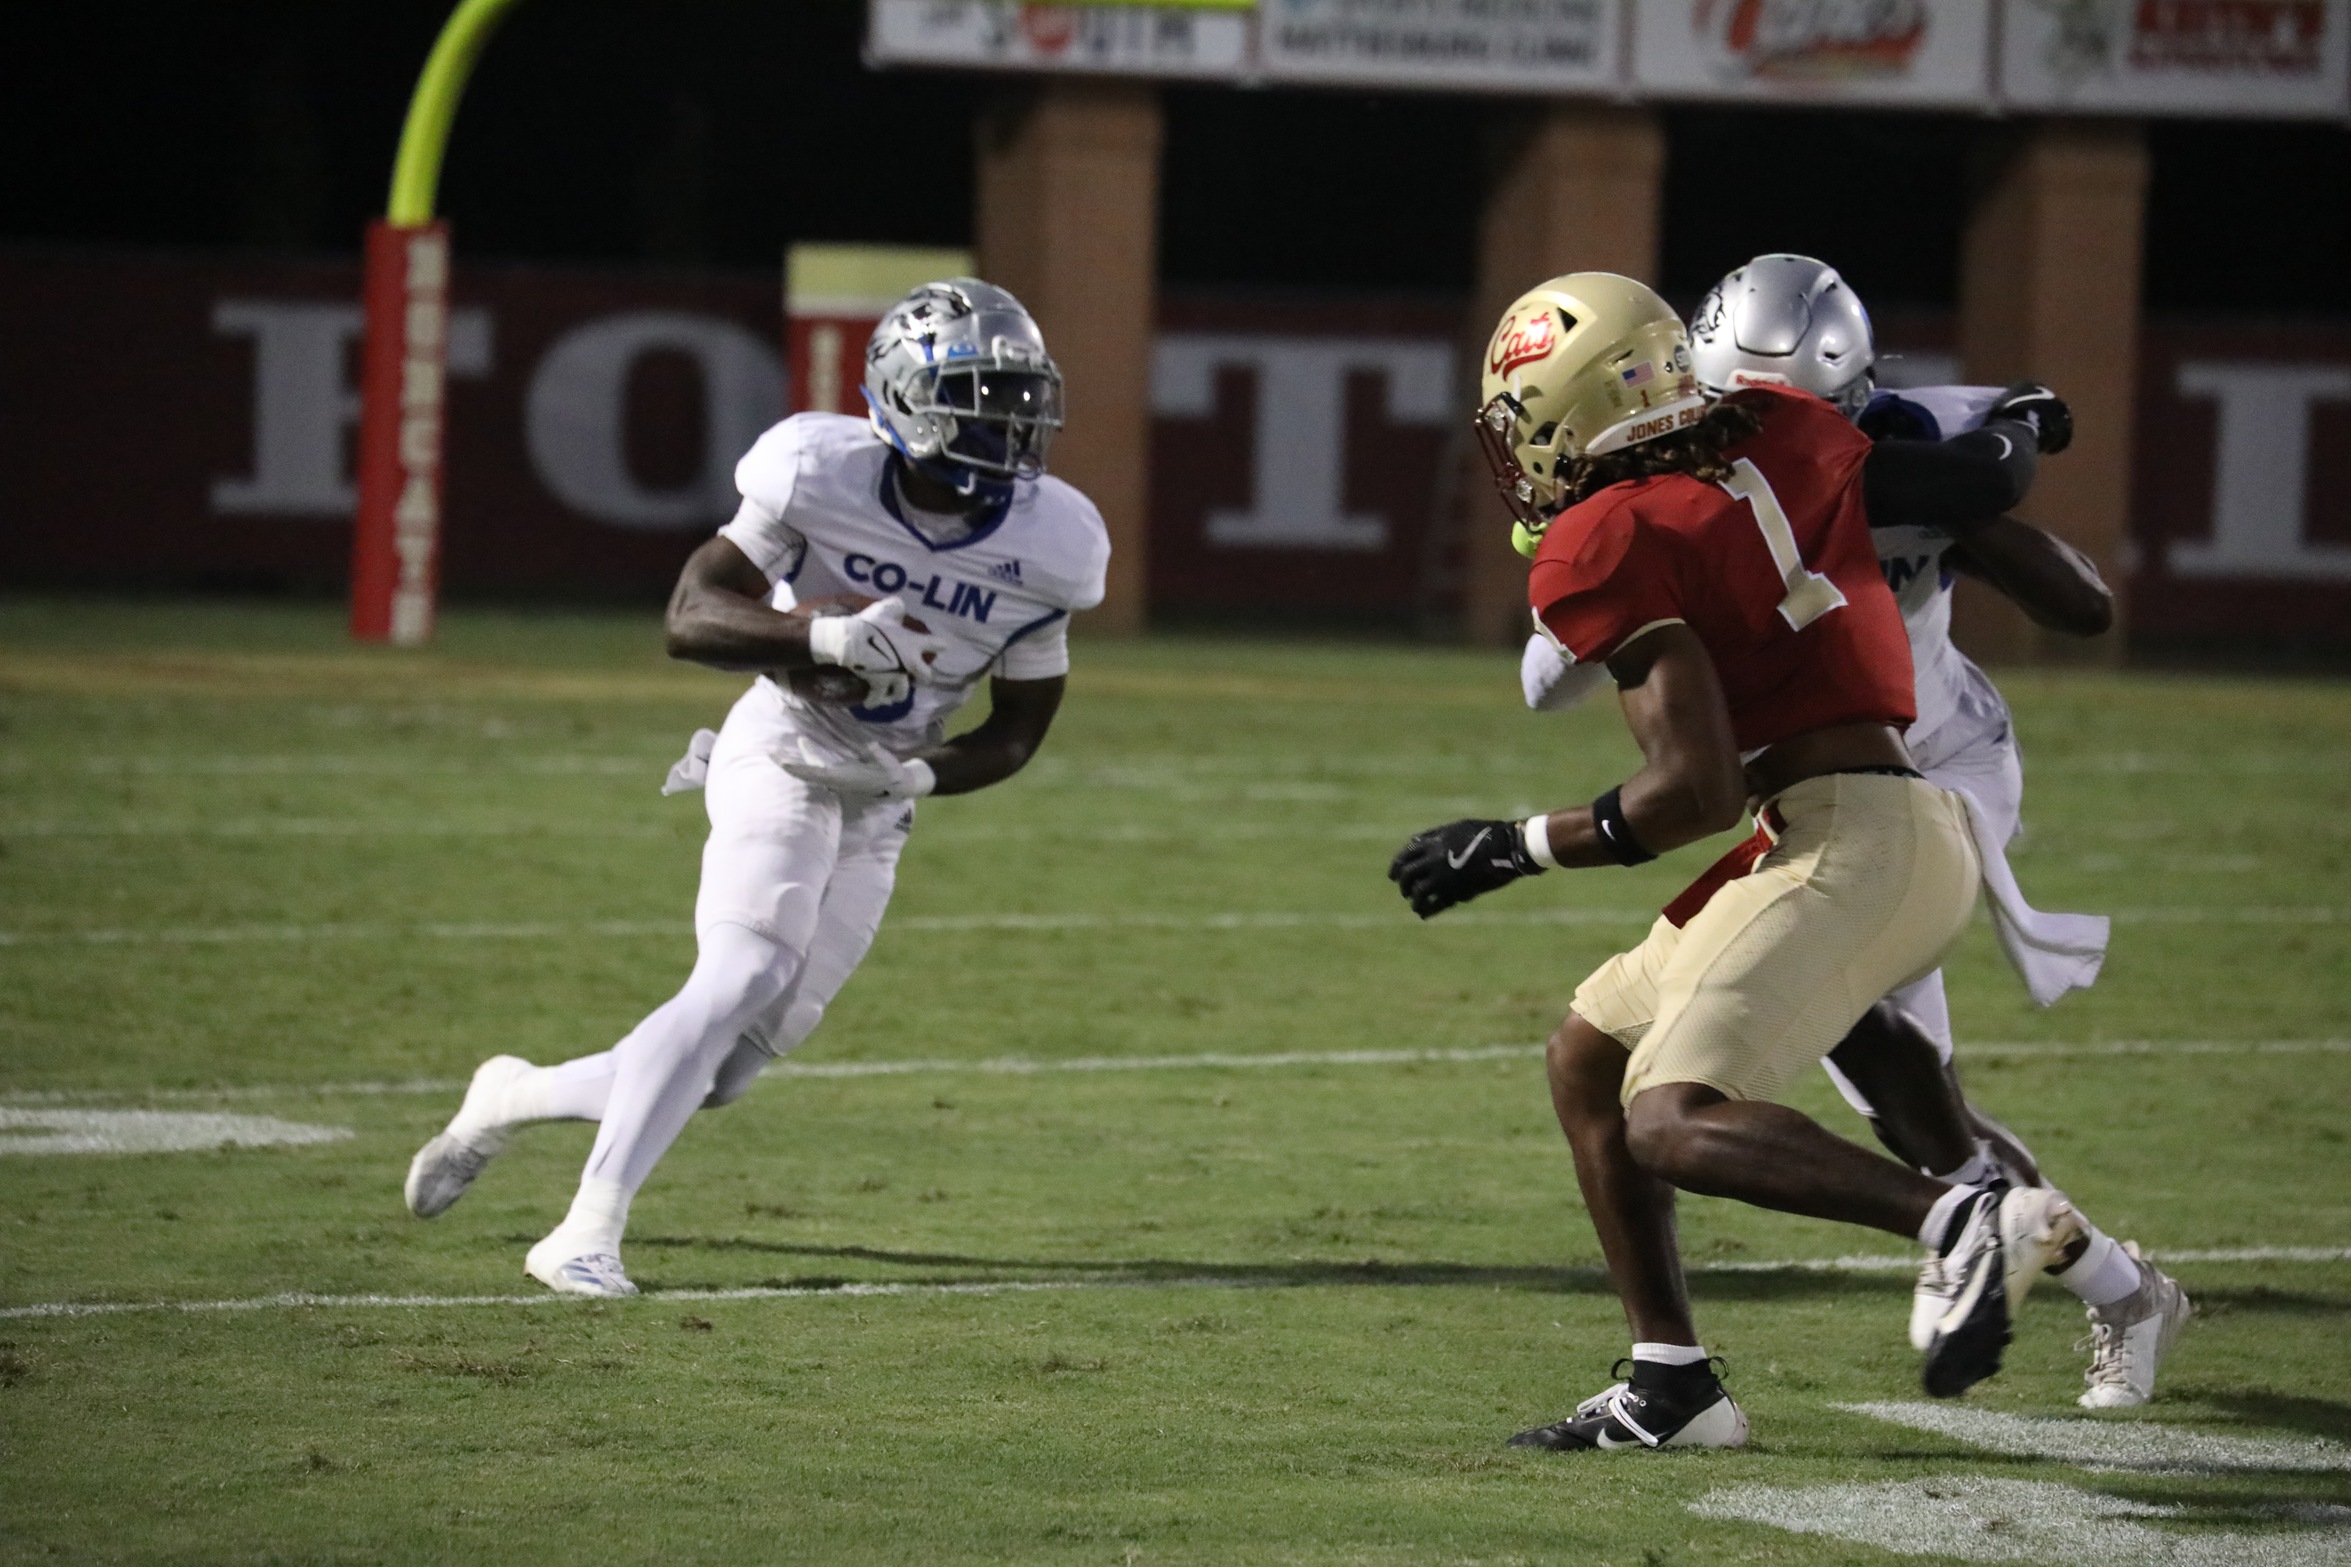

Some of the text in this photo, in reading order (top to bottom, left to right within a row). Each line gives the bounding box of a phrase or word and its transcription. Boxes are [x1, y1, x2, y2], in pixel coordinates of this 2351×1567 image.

[1490, 311, 1556, 382] Cats
[1627, 413, 1674, 442] JONES
[1641, 389, 1651, 408] 1
[1717, 457, 1849, 633] 1
[843, 552, 998, 624] CO-LIN
